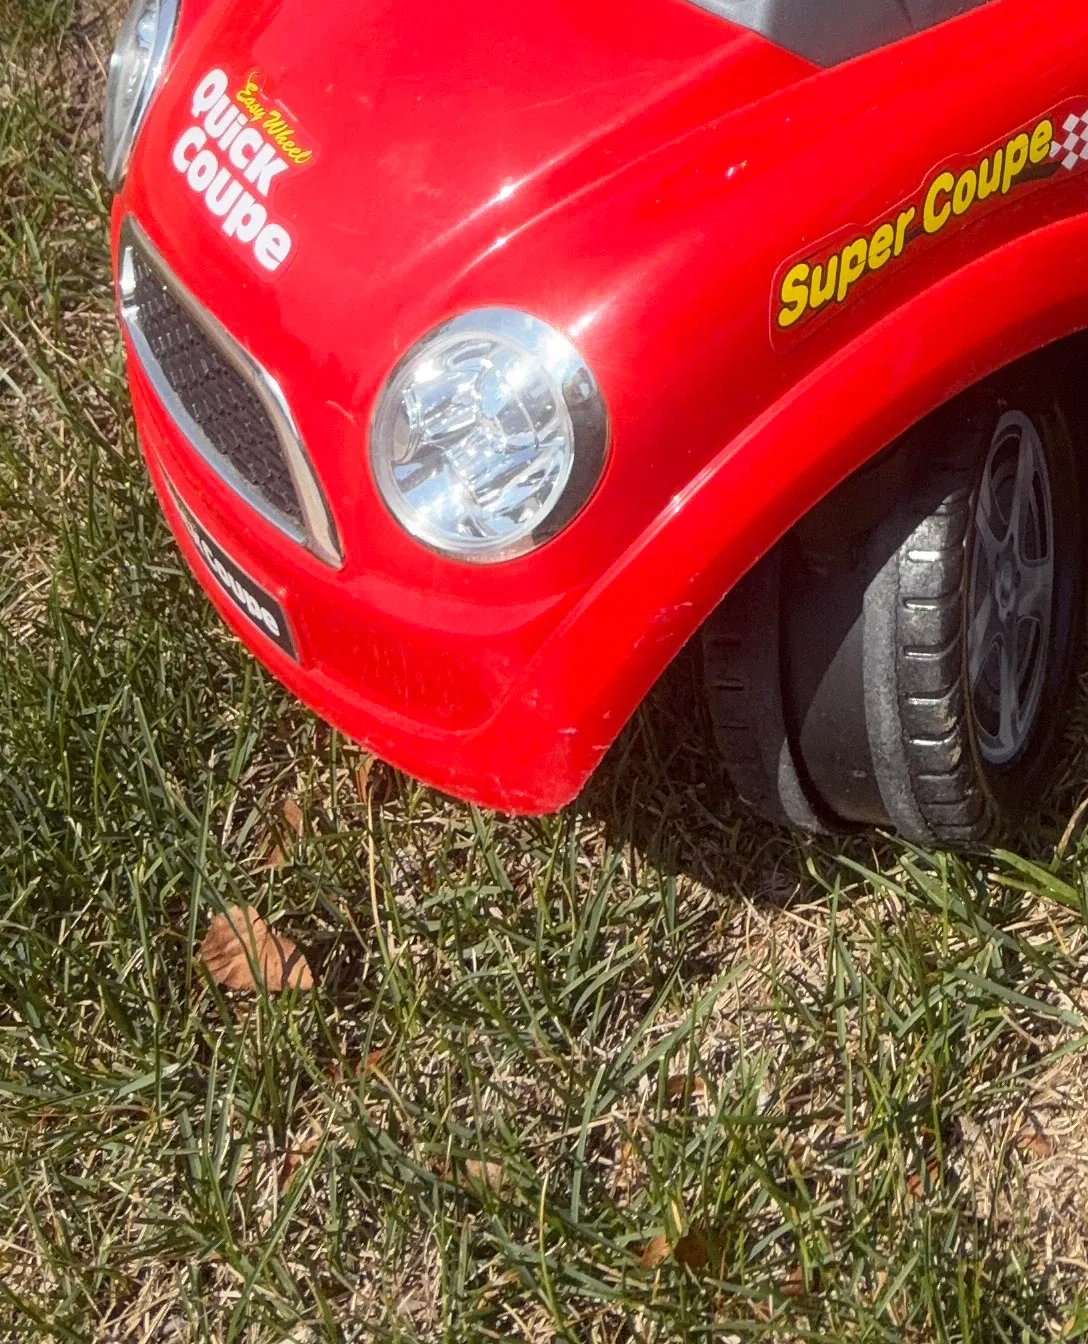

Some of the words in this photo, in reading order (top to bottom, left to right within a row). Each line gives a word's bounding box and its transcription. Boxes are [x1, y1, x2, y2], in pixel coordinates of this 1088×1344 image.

[236, 71, 265, 121] Easy
[262, 110, 313, 164] Wheel
[172, 125, 292, 272] Coupe
[778, 206, 915, 327] Super
[922, 119, 1053, 234] Coupe
